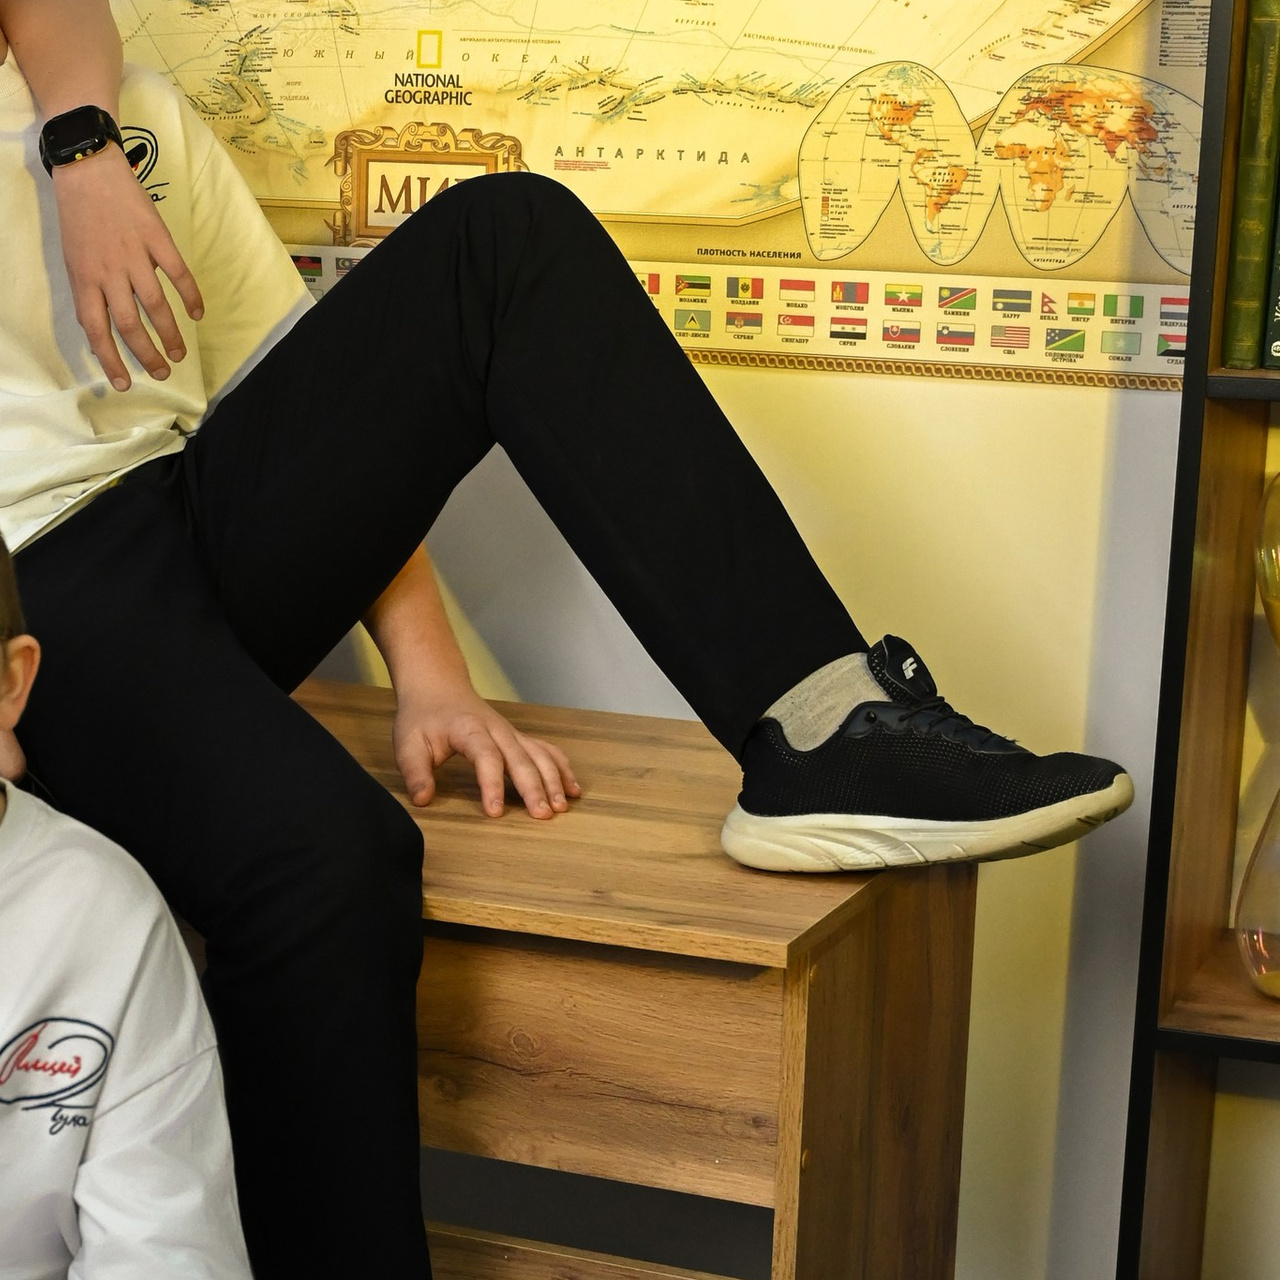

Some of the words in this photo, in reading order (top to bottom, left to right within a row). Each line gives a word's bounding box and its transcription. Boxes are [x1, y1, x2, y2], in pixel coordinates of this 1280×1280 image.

[282, 48, 414, 61] ЮЖНЫЙ
[462, 53, 590, 65] ОКЕАН
[394, 73, 463, 88] NATIONAL
[384, 90, 472, 106] GEOGRAPHIC
[554, 145, 750, 164] АНТАРКТИДА
[697, 248, 747, 258] ПЛОТНОСТЬ
[749, 250, 802, 260] НАСЕЛЕНИЯ
